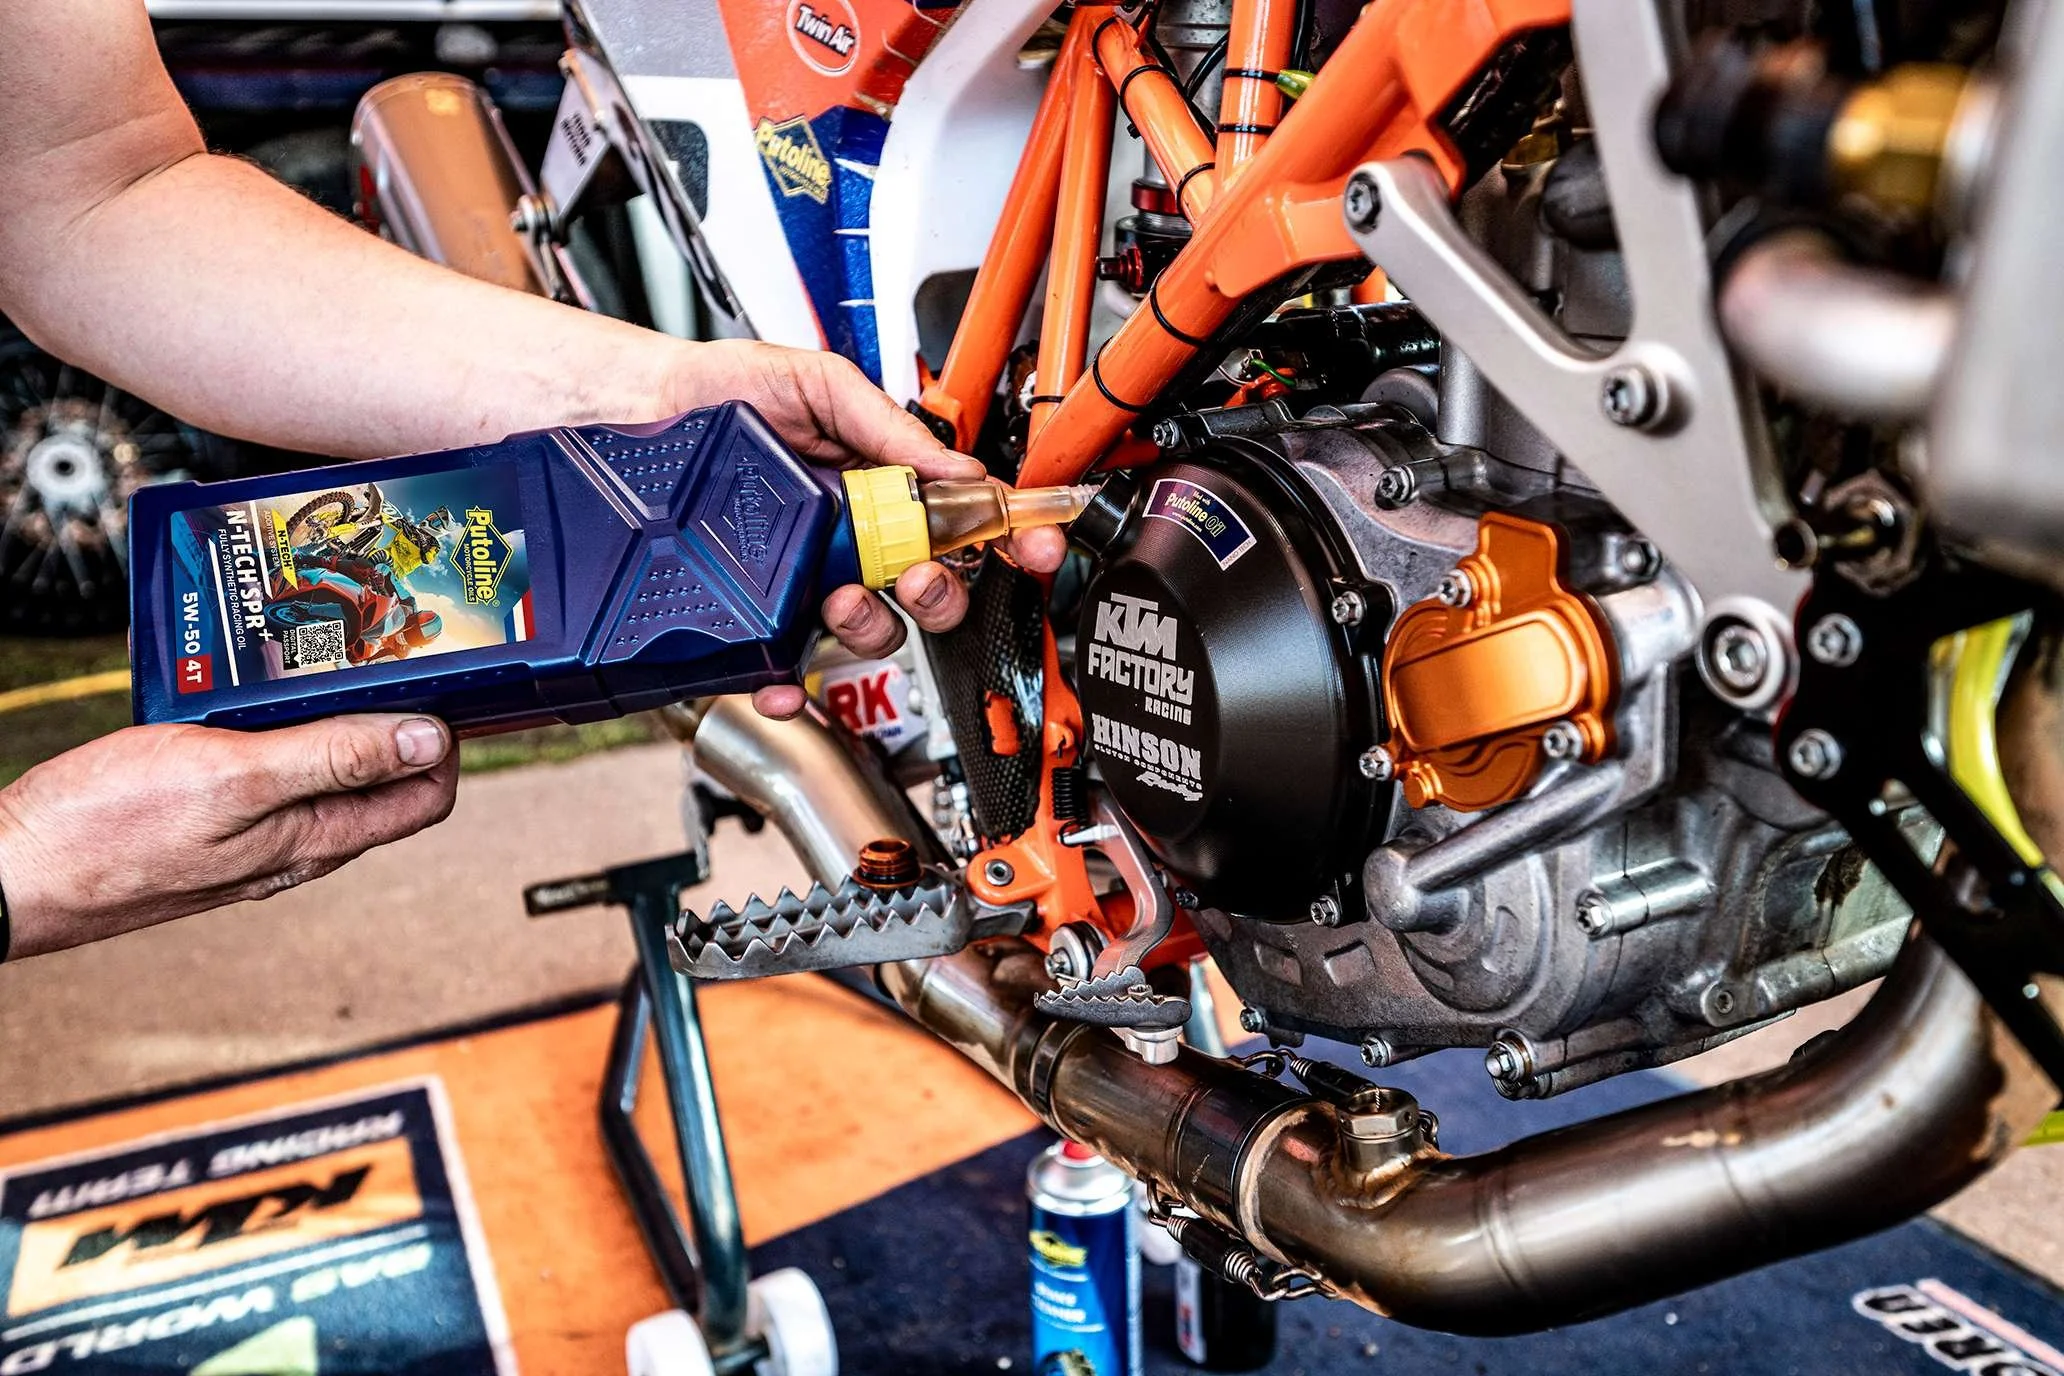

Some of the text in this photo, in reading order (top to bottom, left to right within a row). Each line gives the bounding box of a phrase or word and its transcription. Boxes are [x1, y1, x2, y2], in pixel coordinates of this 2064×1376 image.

[795, 3, 855, 55] Twin Air
[756, 120, 832, 187] Putoline
[1165, 491, 1227, 538] Putoline Oil
[464, 543, 476, 603] MOTORCYCLE OILS
[468, 511, 495, 600] Putoline
[217, 528, 247, 651] FULLY SYNTHETIC RACING OIL
[182, 591, 203, 684] 5W-50 4T
[282, 630, 291, 665] PASSPORT
[289, 629, 297, 654] DIGITAL
[1094, 592, 1178, 662] KTM
[827, 670, 898, 729] RK
[1087, 642, 1194, 706] FACTORY
[1144, 695, 1192, 726] RACING
[1091, 712, 1202, 781] HINSON
[56, 1163, 374, 1270] KTM
[0, 1287, 275, 1376] WORLD
